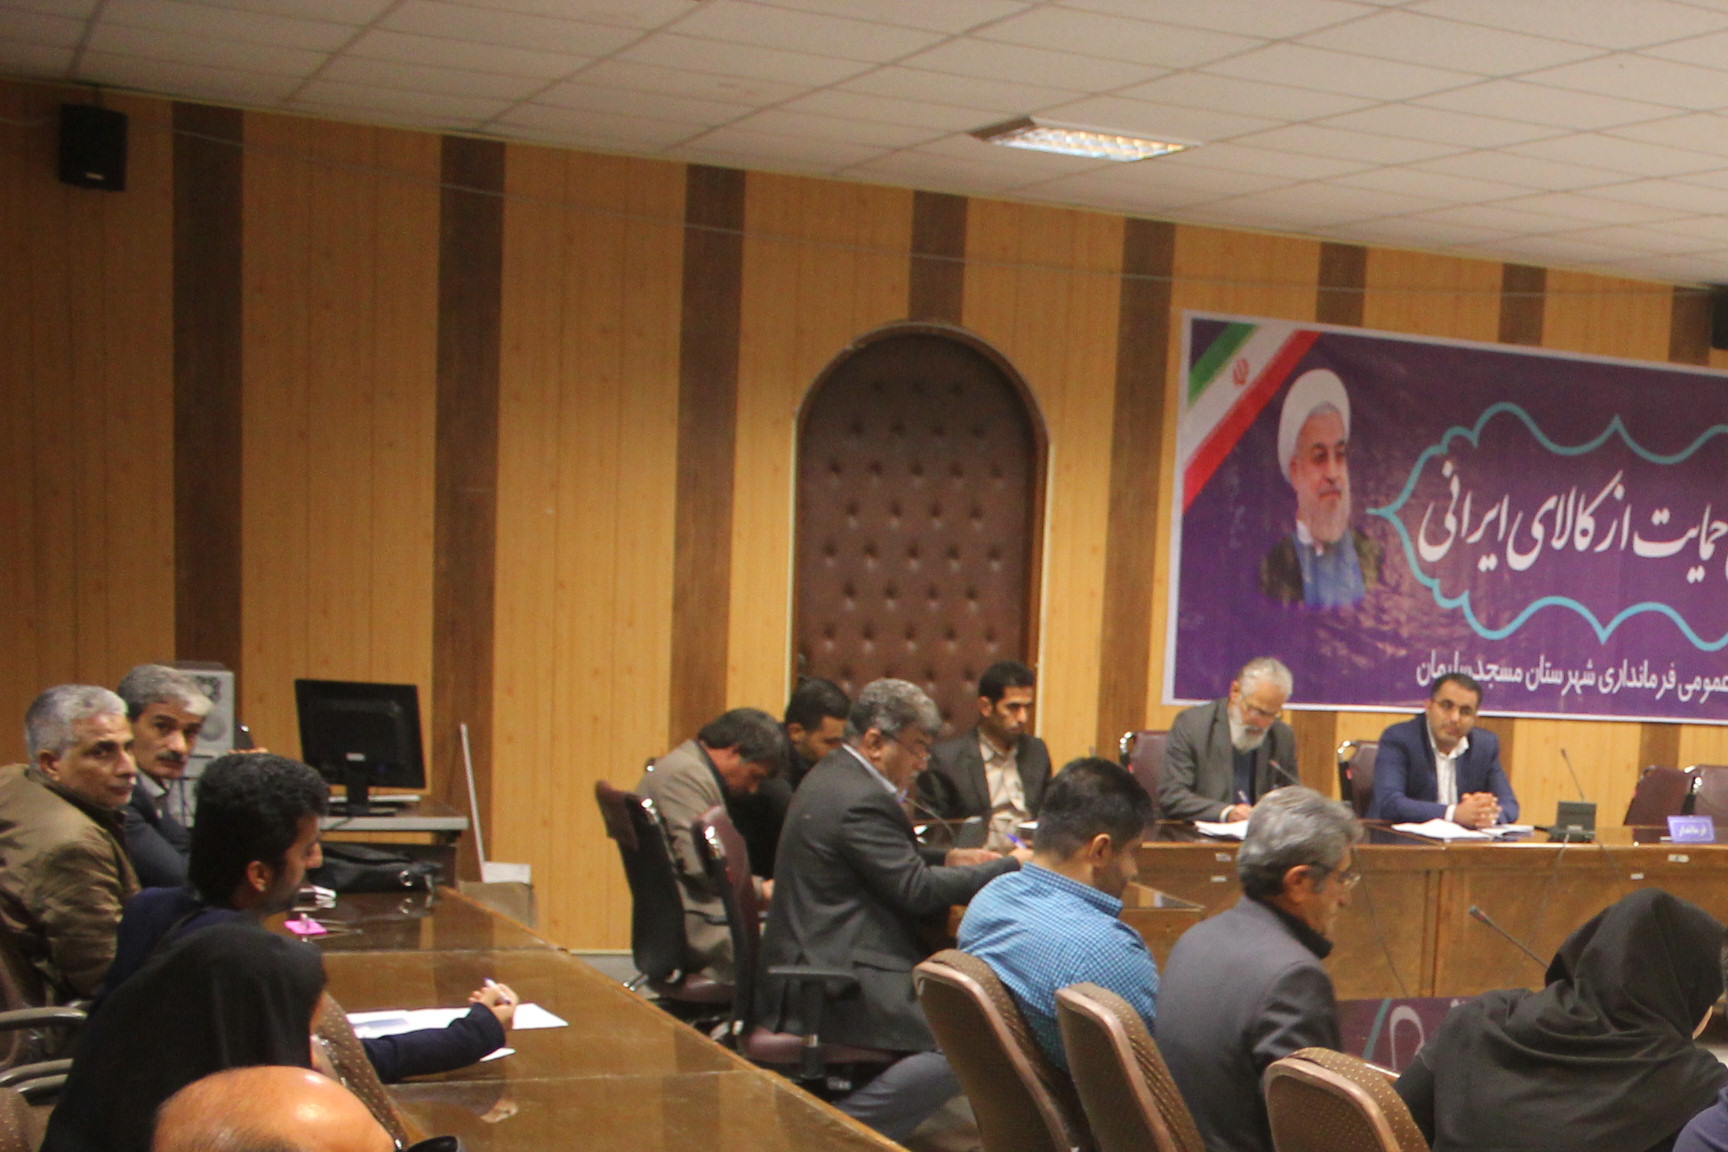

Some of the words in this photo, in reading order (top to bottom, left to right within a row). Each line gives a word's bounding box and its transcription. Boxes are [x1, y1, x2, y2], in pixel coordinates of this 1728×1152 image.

[1417, 460, 1509, 572] ایرانی
[1506, 470, 1623, 571] کالای
[1594, 483, 1632, 553] از
[1525, 654, 1596, 696] شهرستان
[1597, 658, 1677, 700] فرمانداری
